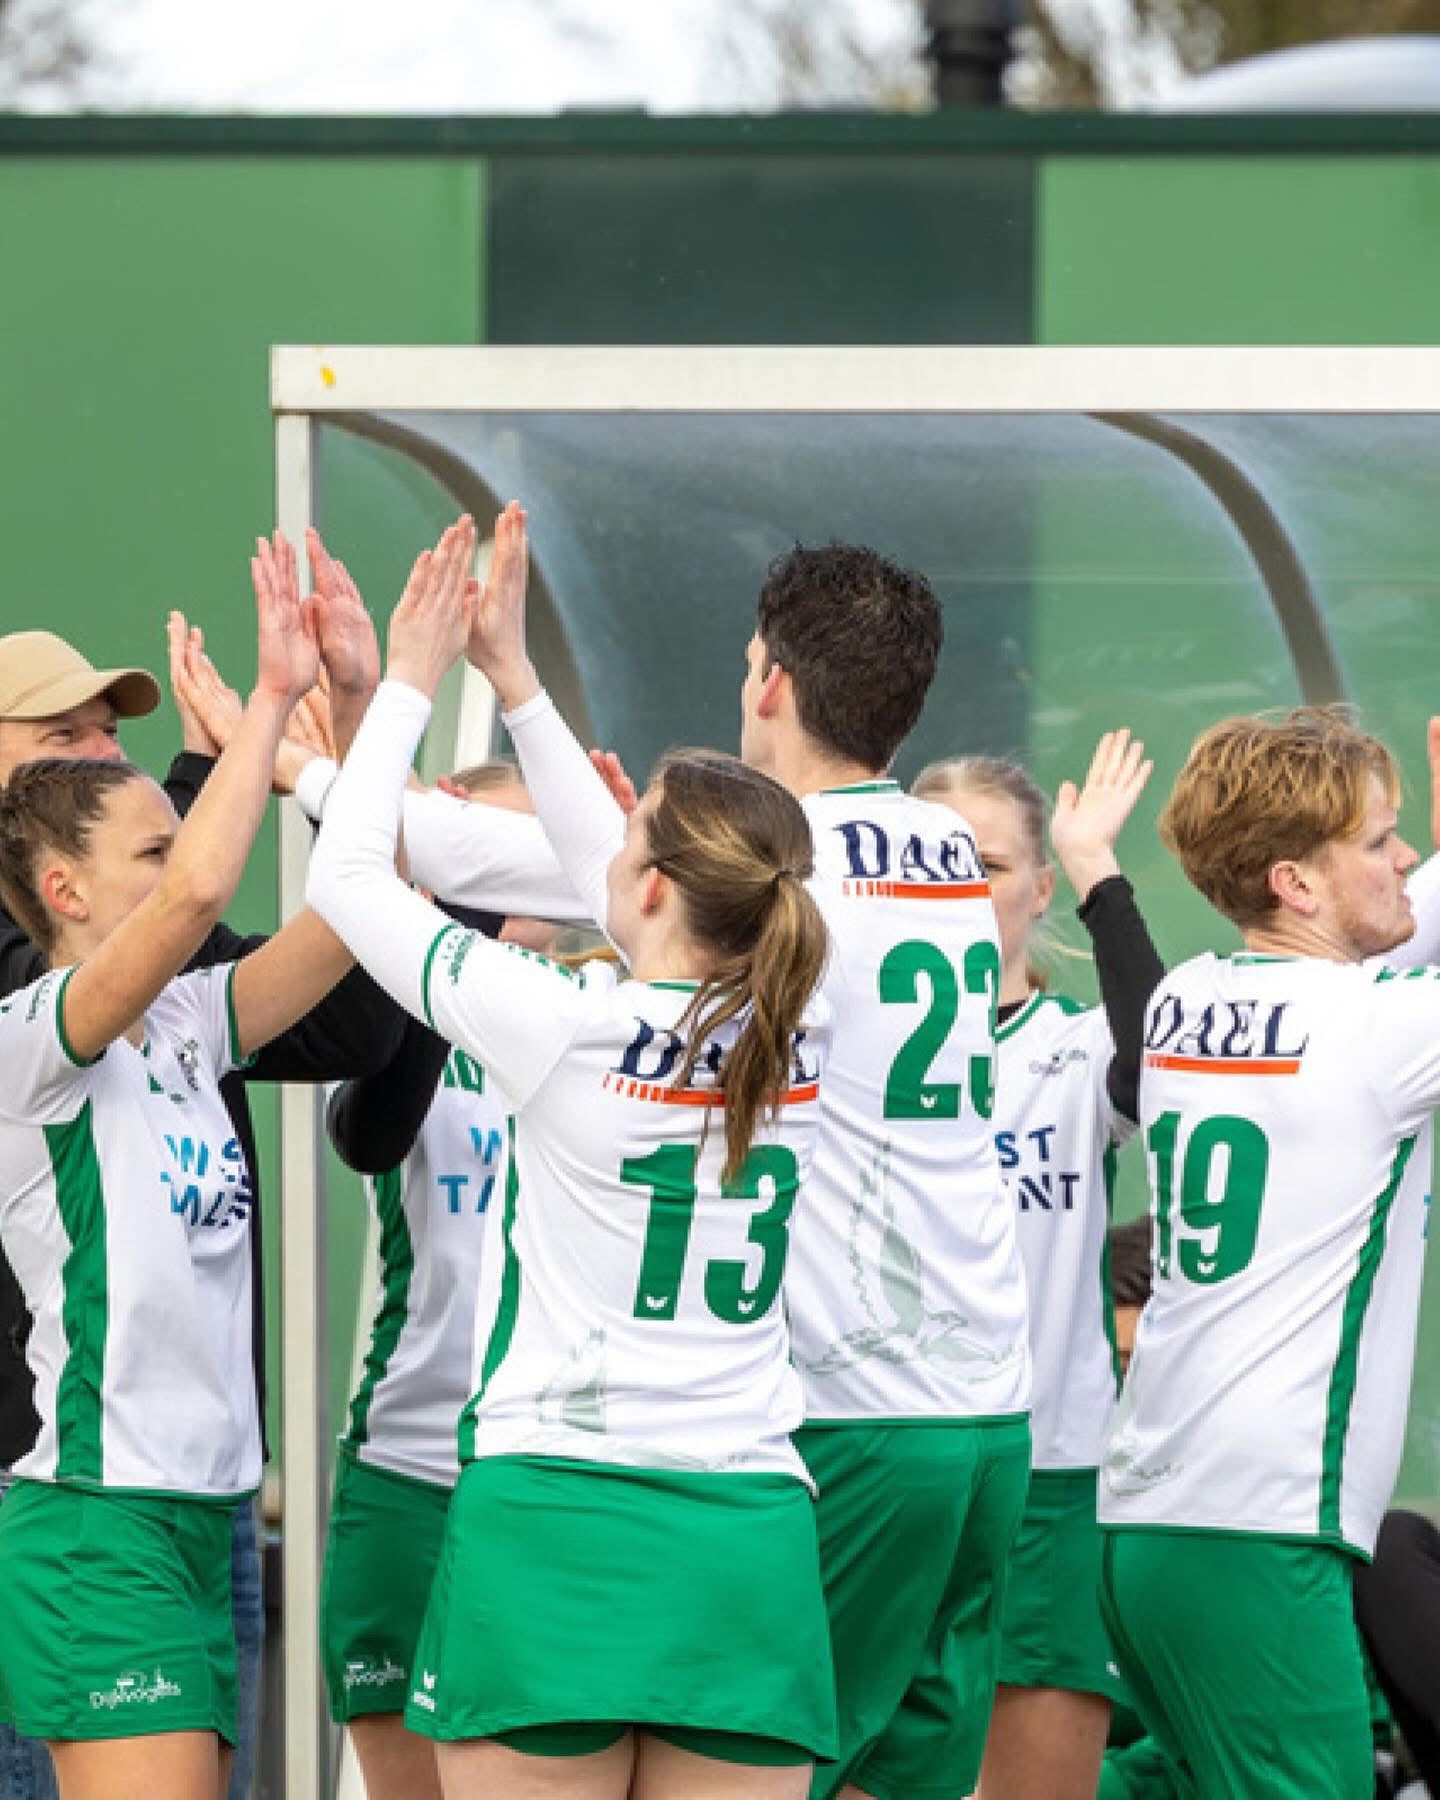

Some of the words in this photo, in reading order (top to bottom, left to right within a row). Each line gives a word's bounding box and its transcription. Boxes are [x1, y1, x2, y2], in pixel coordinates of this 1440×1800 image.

[879, 940, 999, 1119] 23
[1146, 993, 1309, 1057] DAEL
[620, 1144, 799, 1324] 13
[1148, 1110, 1269, 1284] 19
